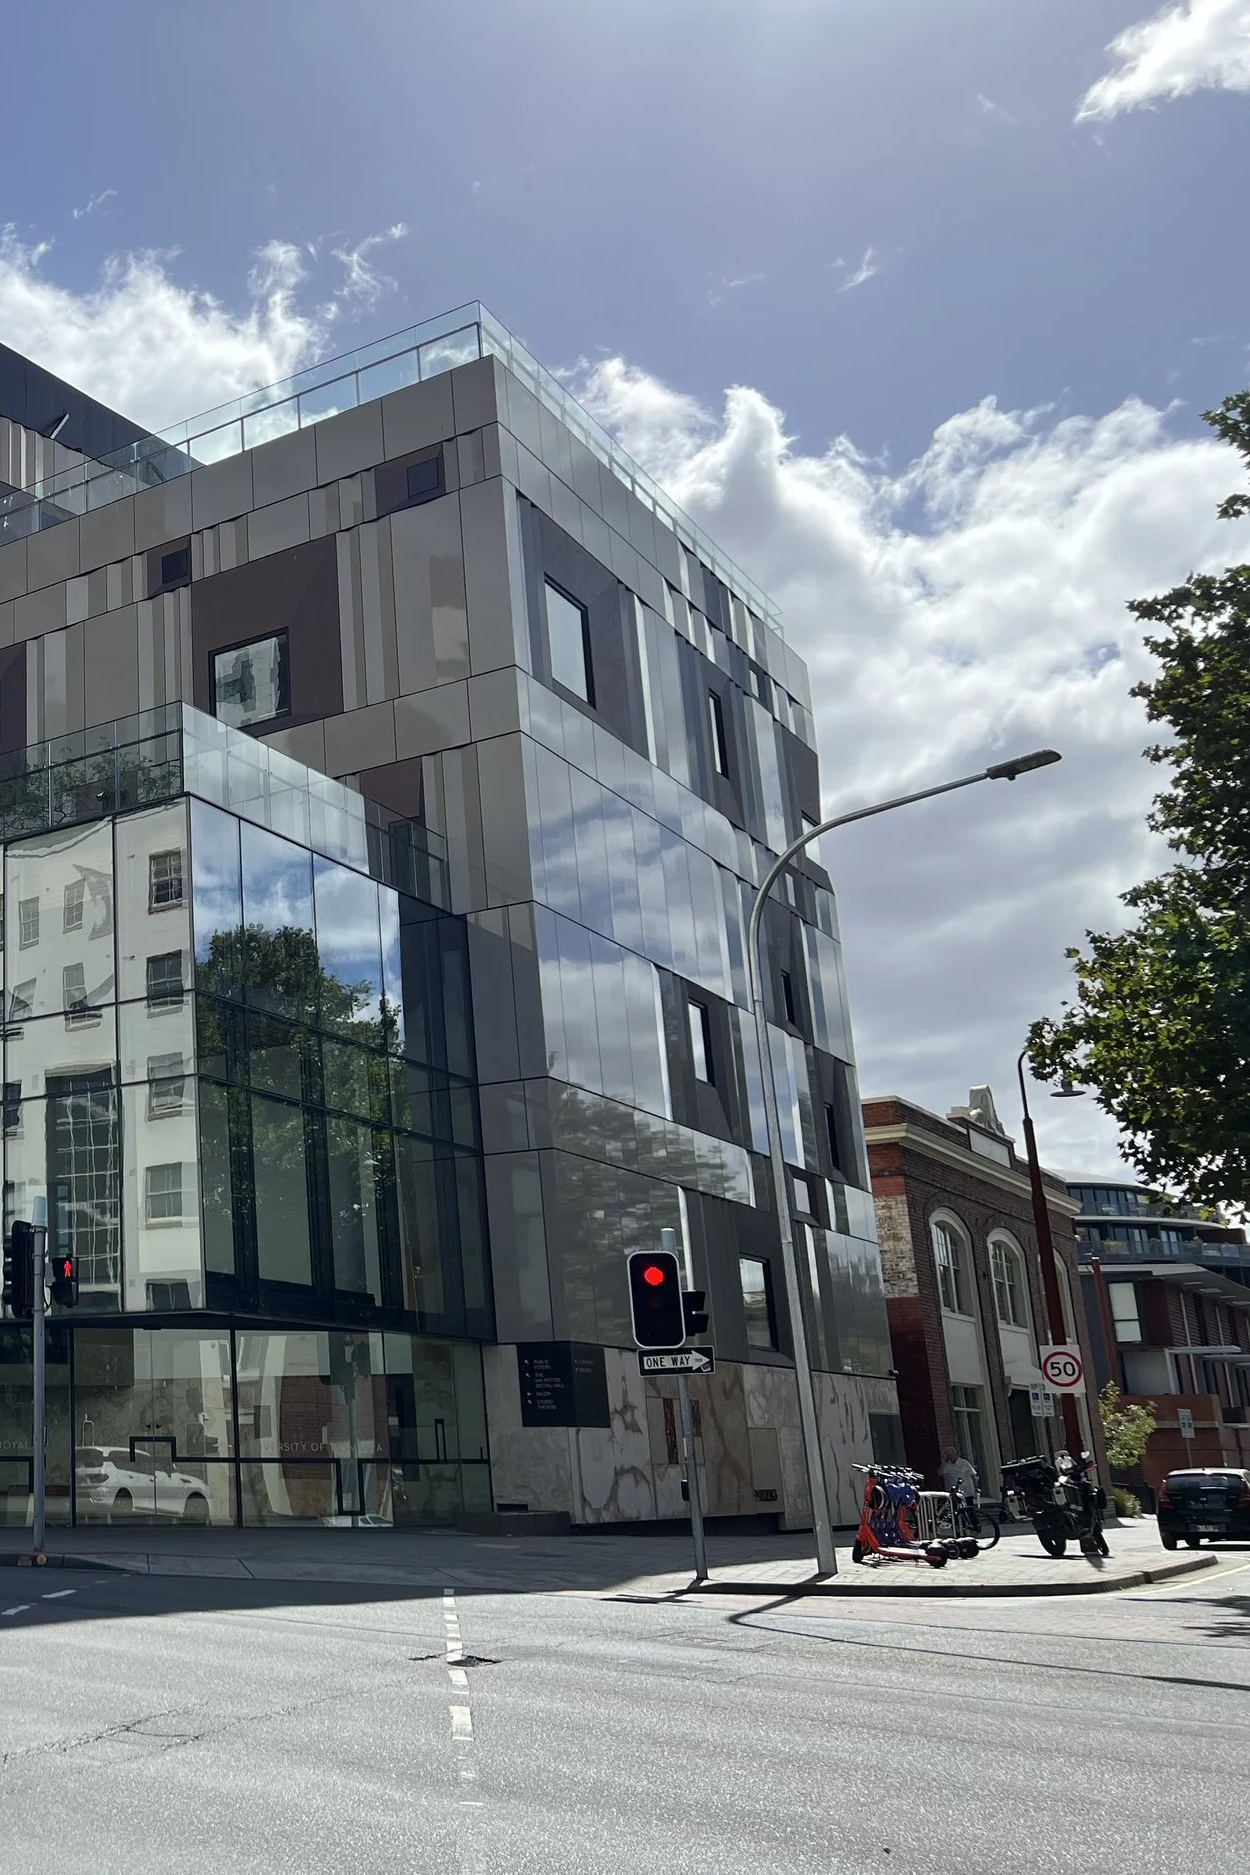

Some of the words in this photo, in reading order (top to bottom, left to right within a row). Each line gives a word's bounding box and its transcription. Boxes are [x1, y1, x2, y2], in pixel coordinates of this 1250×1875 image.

[646, 1357, 665, 1368] ONE
[671, 1355, 691, 1367] WAY
[1050, 1361, 1076, 1377] 50
[310, 1443, 325, 1452] OF
